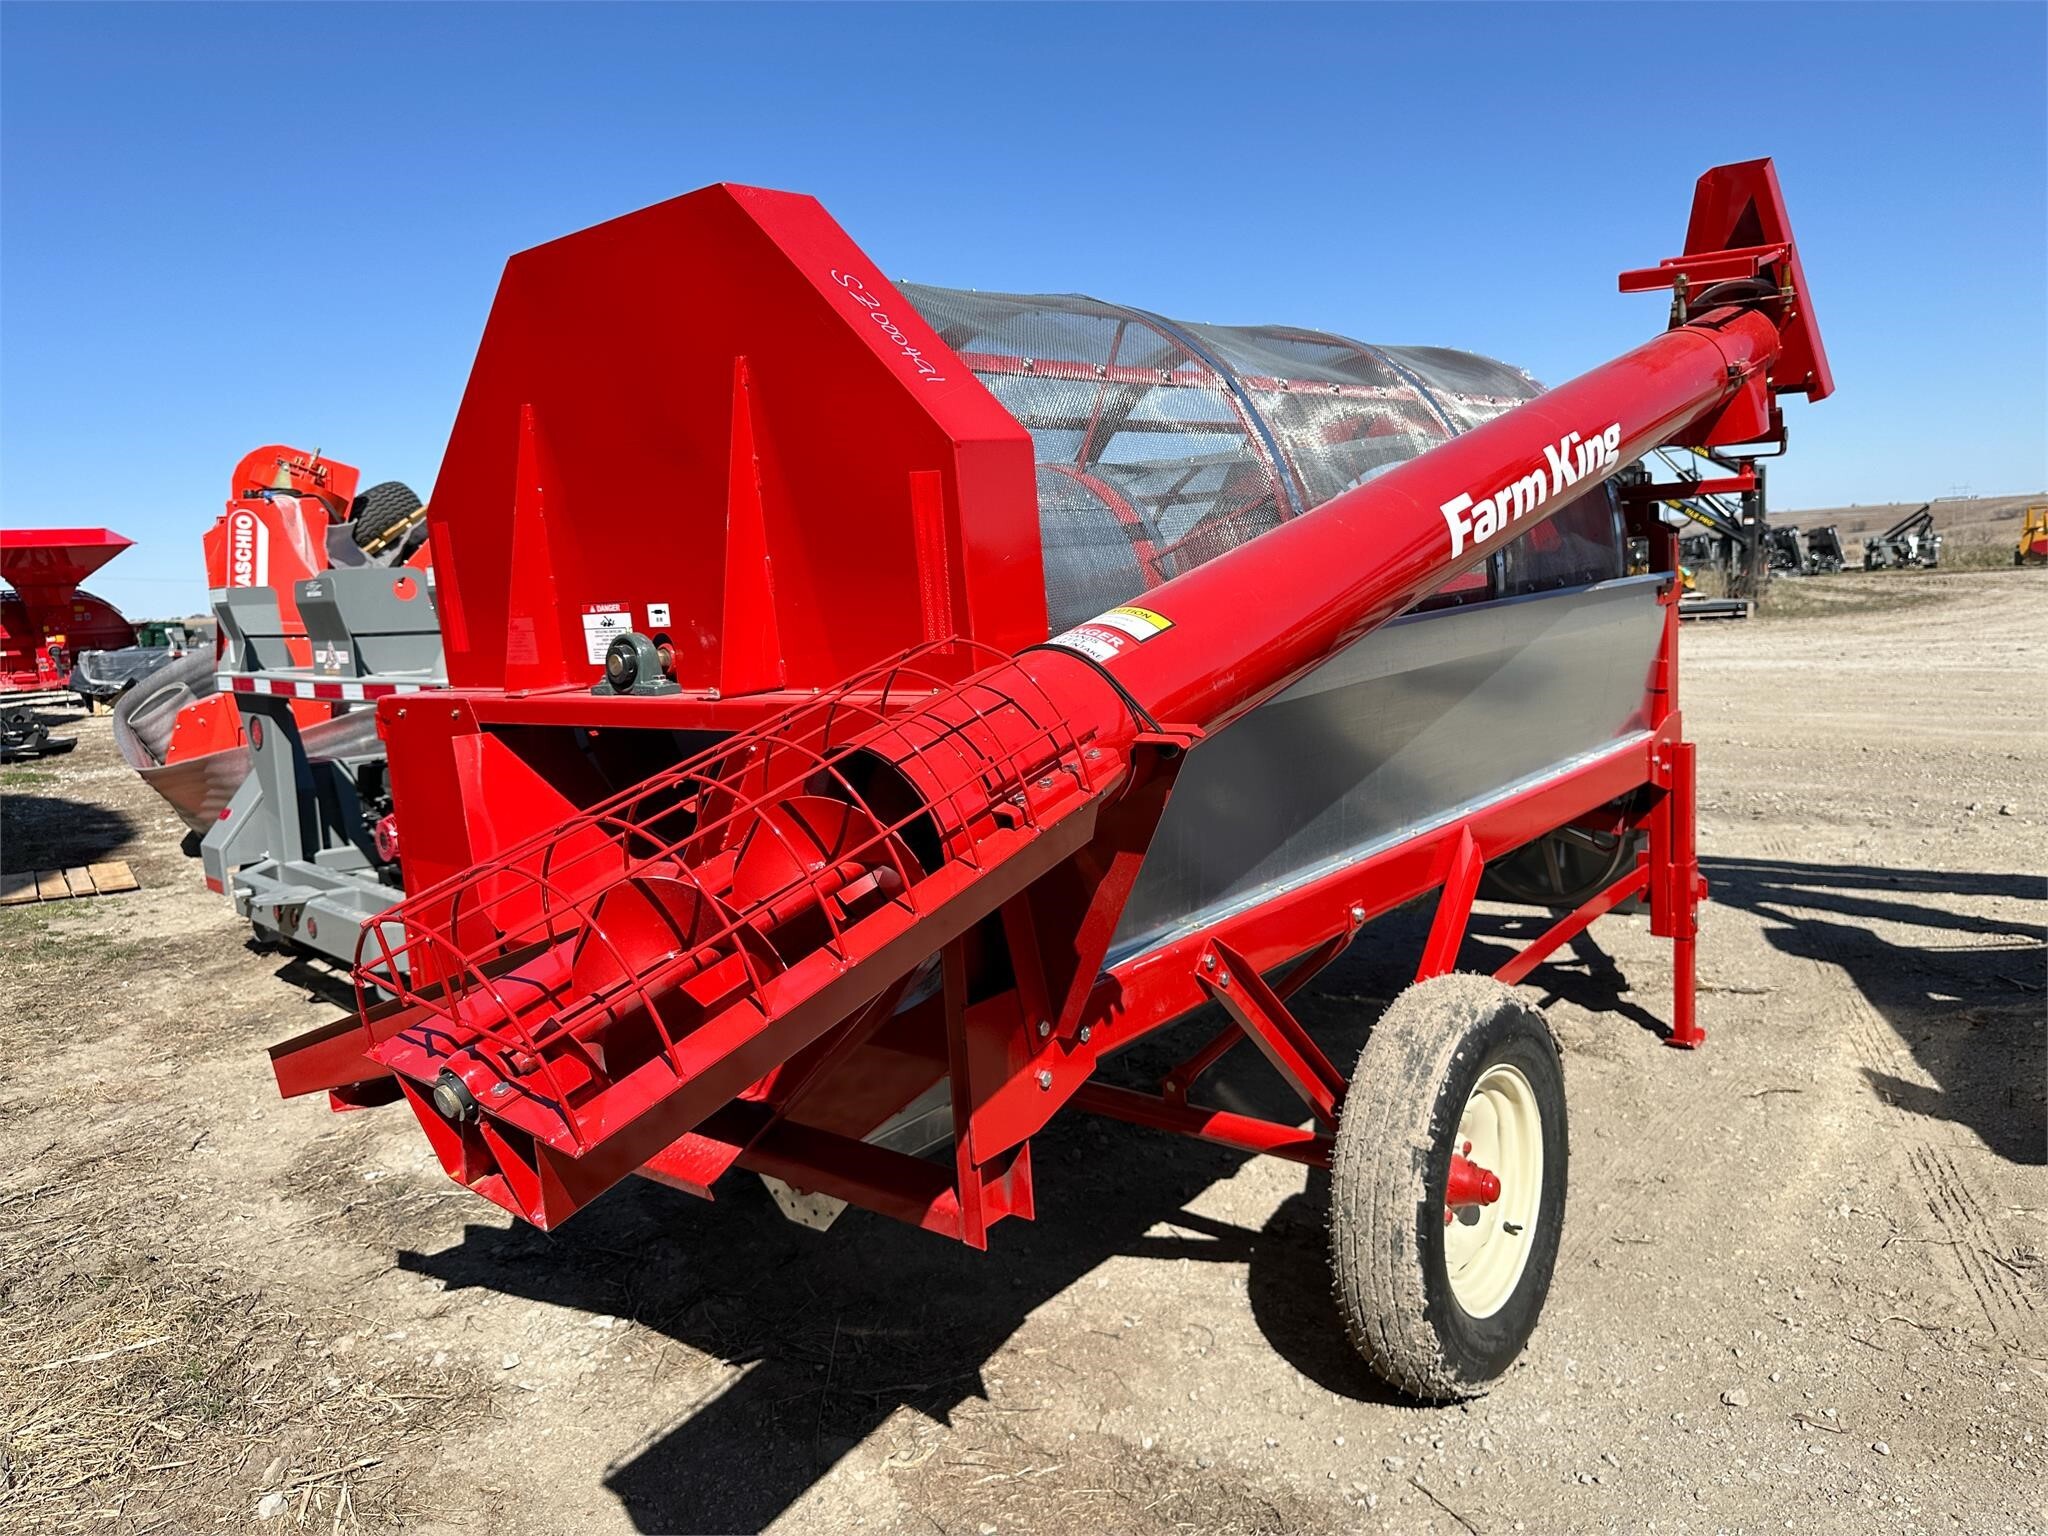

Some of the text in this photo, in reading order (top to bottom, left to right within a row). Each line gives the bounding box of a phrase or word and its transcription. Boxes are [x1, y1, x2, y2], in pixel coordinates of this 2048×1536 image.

[1440, 422, 1621, 560] Farm King
[234, 515, 253, 588] ASCHIO
[596, 602, 620, 612] DANGER
